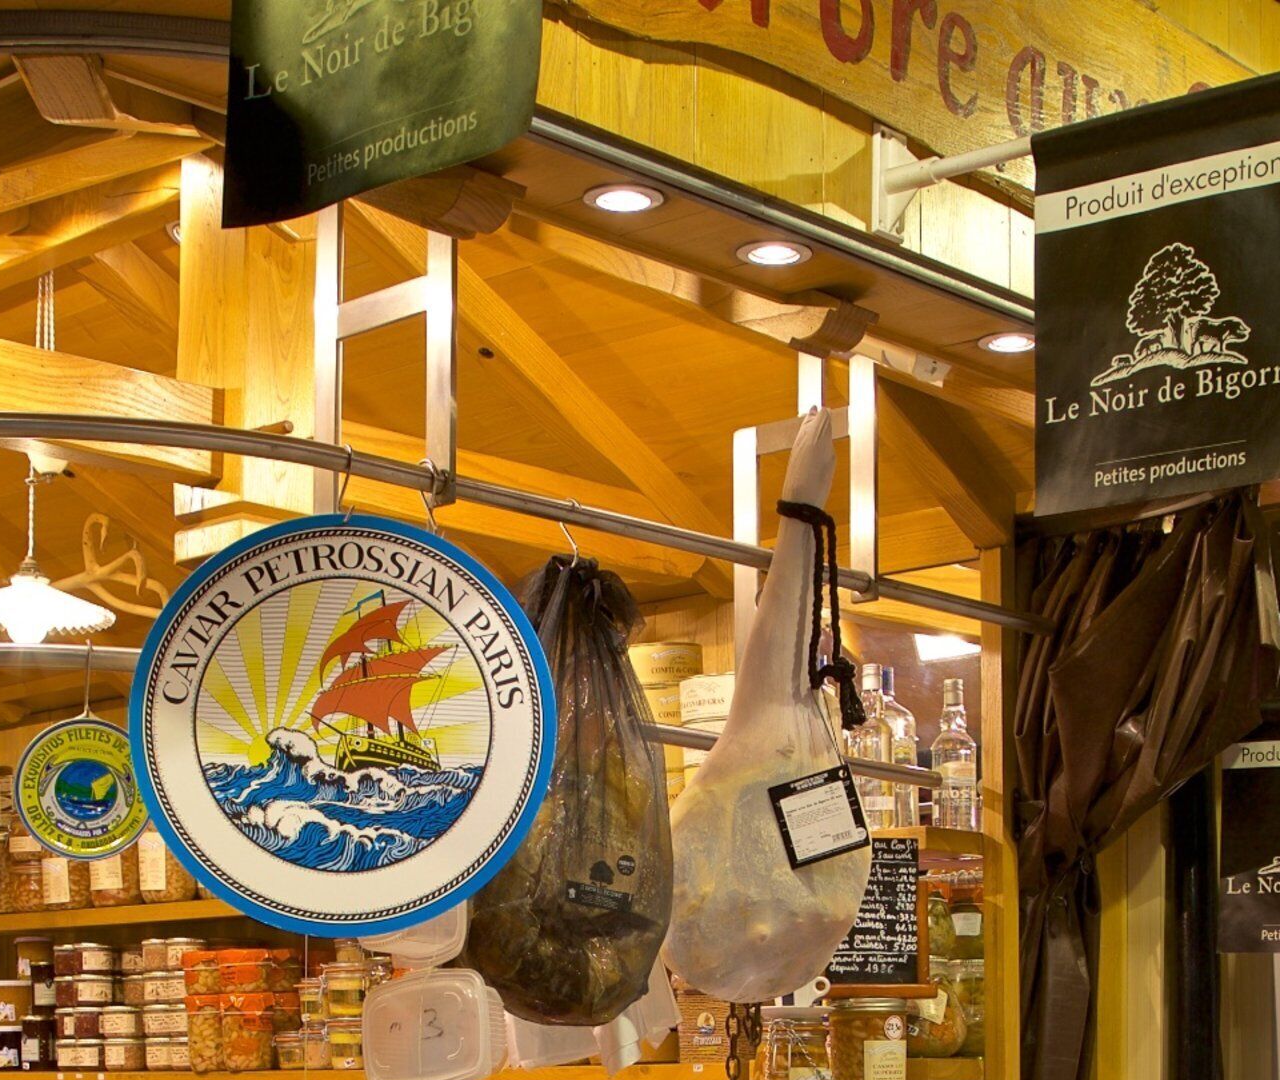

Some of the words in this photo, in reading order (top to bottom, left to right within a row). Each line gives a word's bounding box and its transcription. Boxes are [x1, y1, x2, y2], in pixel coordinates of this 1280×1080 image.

[245, 61, 289, 101] Le
[300, 34, 369, 88] Noir
[373, 11, 408, 52] de
[306, 150, 360, 187] Petites
[363, 109, 478, 172] productions
[1065, 187, 1144, 221] Produit
[1045, 396, 1080, 425] Le
[1088, 376, 1148, 418] Noir
[1157, 377, 1185, 405] de
[1094, 462, 1146, 488] Petites
[1150, 449, 1246, 484] productions
[162, 593, 244, 705] CAVIAR
[242, 541, 469, 613] PETROSSIAN
[463, 608, 524, 711] PARIS
[1226, 877, 1251, 895] Le
